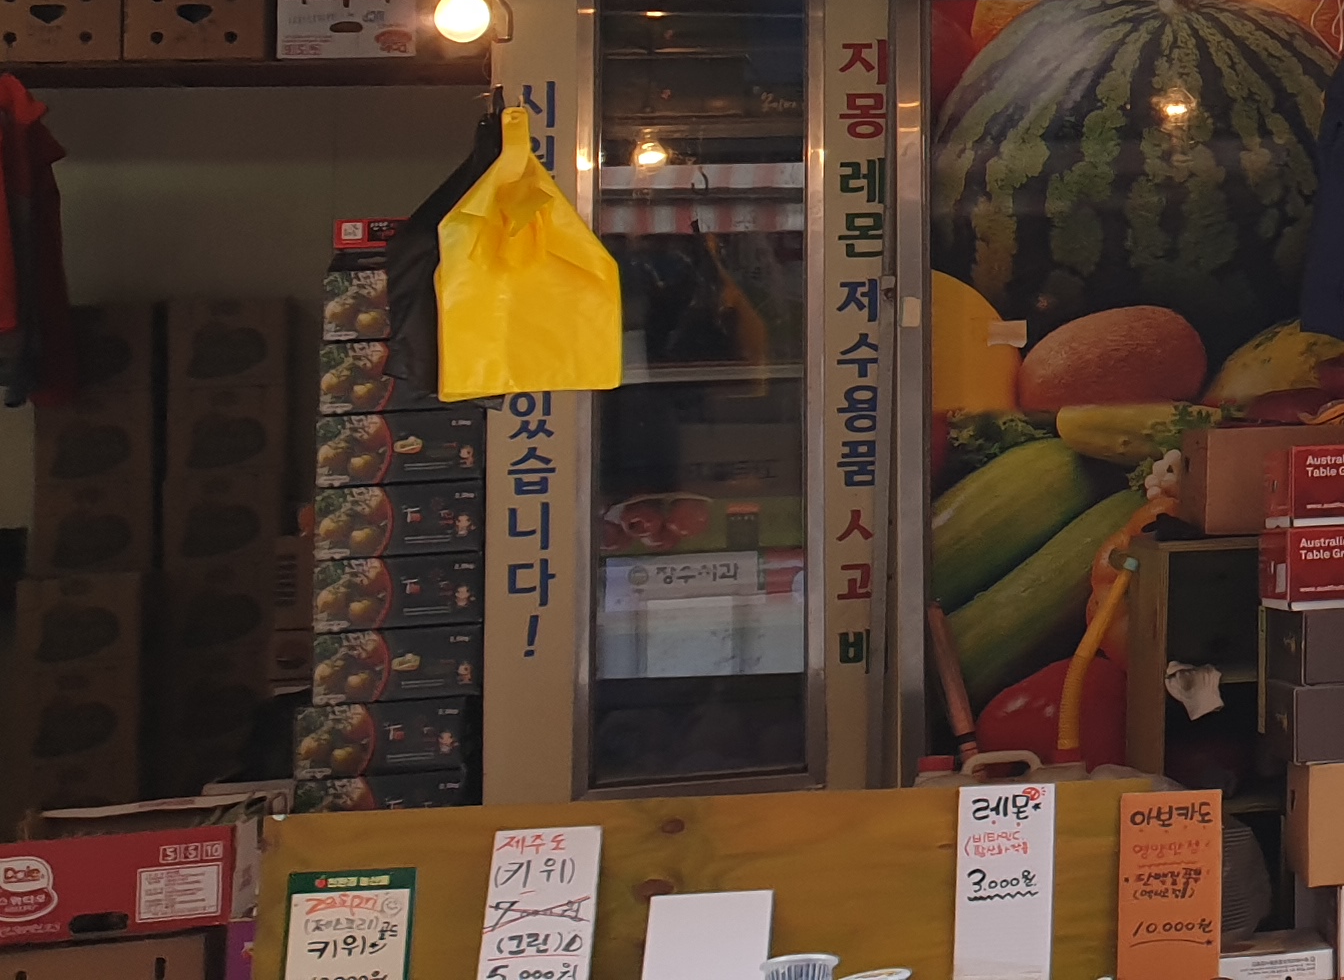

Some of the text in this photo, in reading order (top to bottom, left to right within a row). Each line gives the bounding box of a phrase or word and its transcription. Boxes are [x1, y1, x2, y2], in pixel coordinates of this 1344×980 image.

[1306, 466, 1337, 477] Table
[1300, 550, 1331, 561] Table
[972, 794, 1031, 821] 레몬
[1130, 801, 1213, 827] 아보카도
[496, 833, 567, 855] 제주도
[307, 935, 367, 960] 키위
